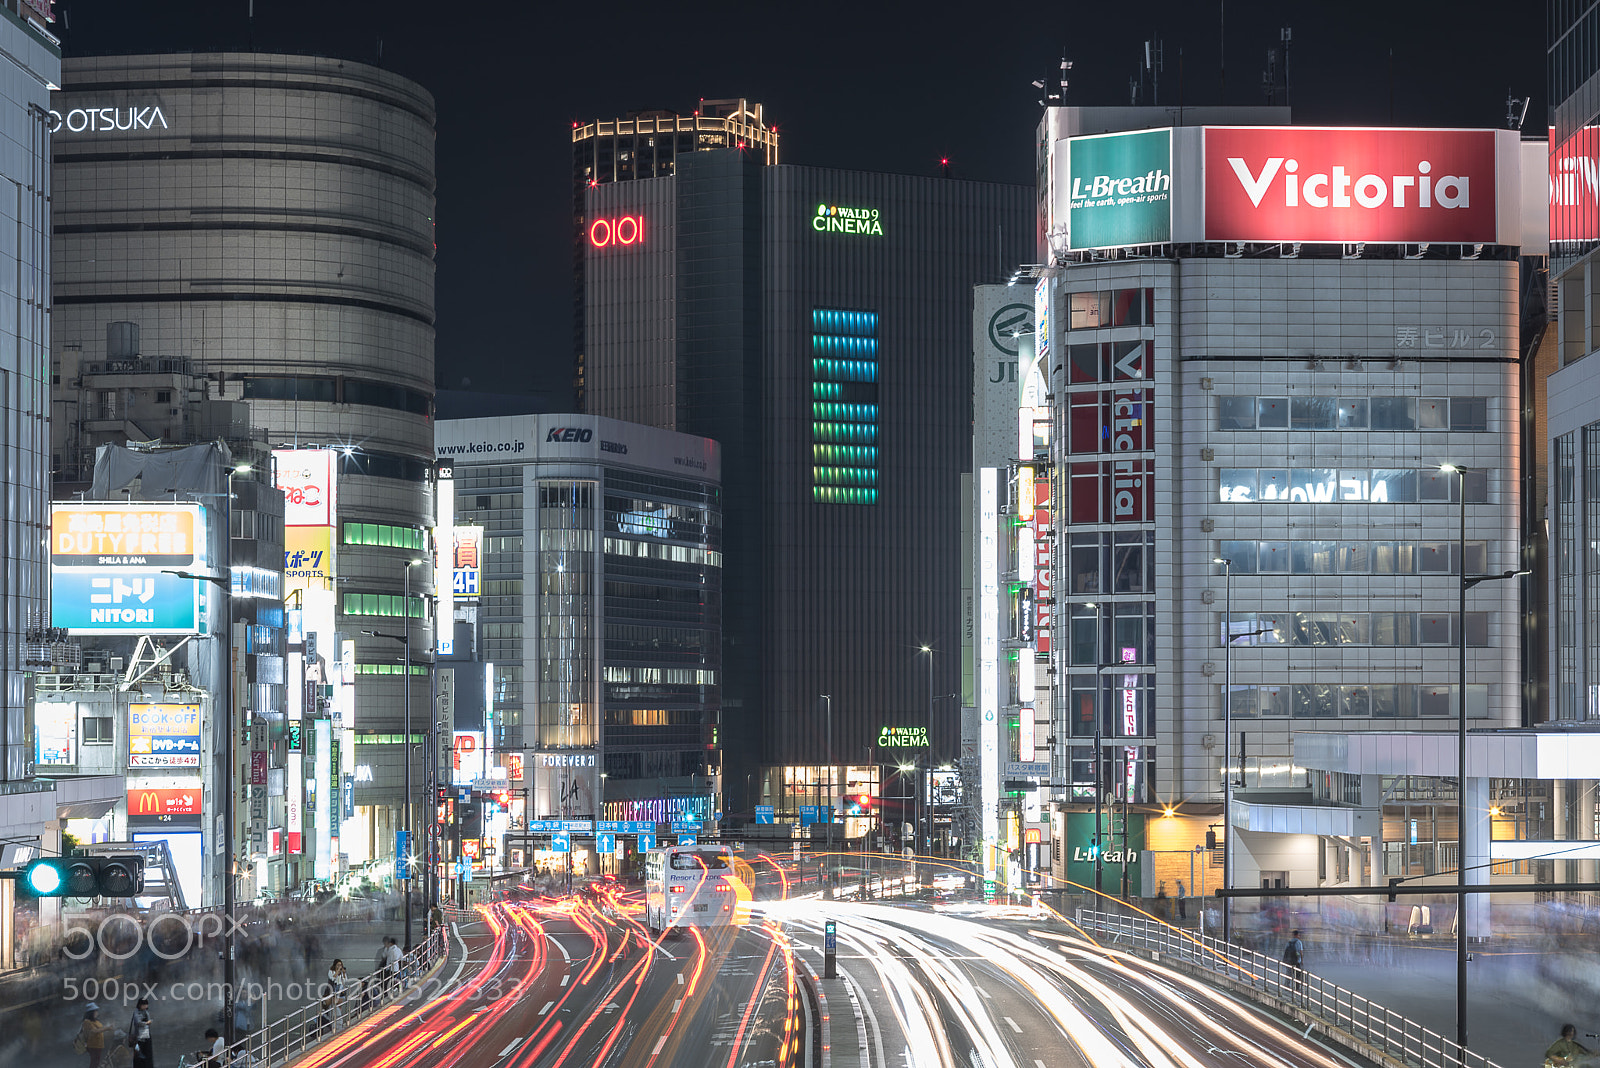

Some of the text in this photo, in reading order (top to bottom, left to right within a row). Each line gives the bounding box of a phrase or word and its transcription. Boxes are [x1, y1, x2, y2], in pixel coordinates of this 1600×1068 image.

[66, 106, 168, 132] OTSUKA
[1071, 169, 1170, 200] L-Breath
[1227, 157, 1470, 208] Victoria
[1084, 199, 1095, 208] the
[1096, 196, 1116, 207] earth,
[1117, 194, 1146, 207] open-air
[1146, 192, 1168, 204] sports
[837, 207, 879, 222] WALD 9
[812, 215, 883, 236] CINEMA
[546, 427, 593, 443] KEIO
[437, 440, 525, 455] www.keio.co.jp
[286, 570, 324, 578] SPORTS
[91, 578, 154, 604] ニトリ
[91, 609, 154, 622] NITORI
[442, 642, 450, 652] P
[896, 726, 927, 737] WALD 9
[878, 735, 930, 747] CINEMA
[542, 755, 595, 767] FOREVER 21
[599, 822, 618, 830] 日本橋
[1074, 846, 1137, 862] L-Beah
